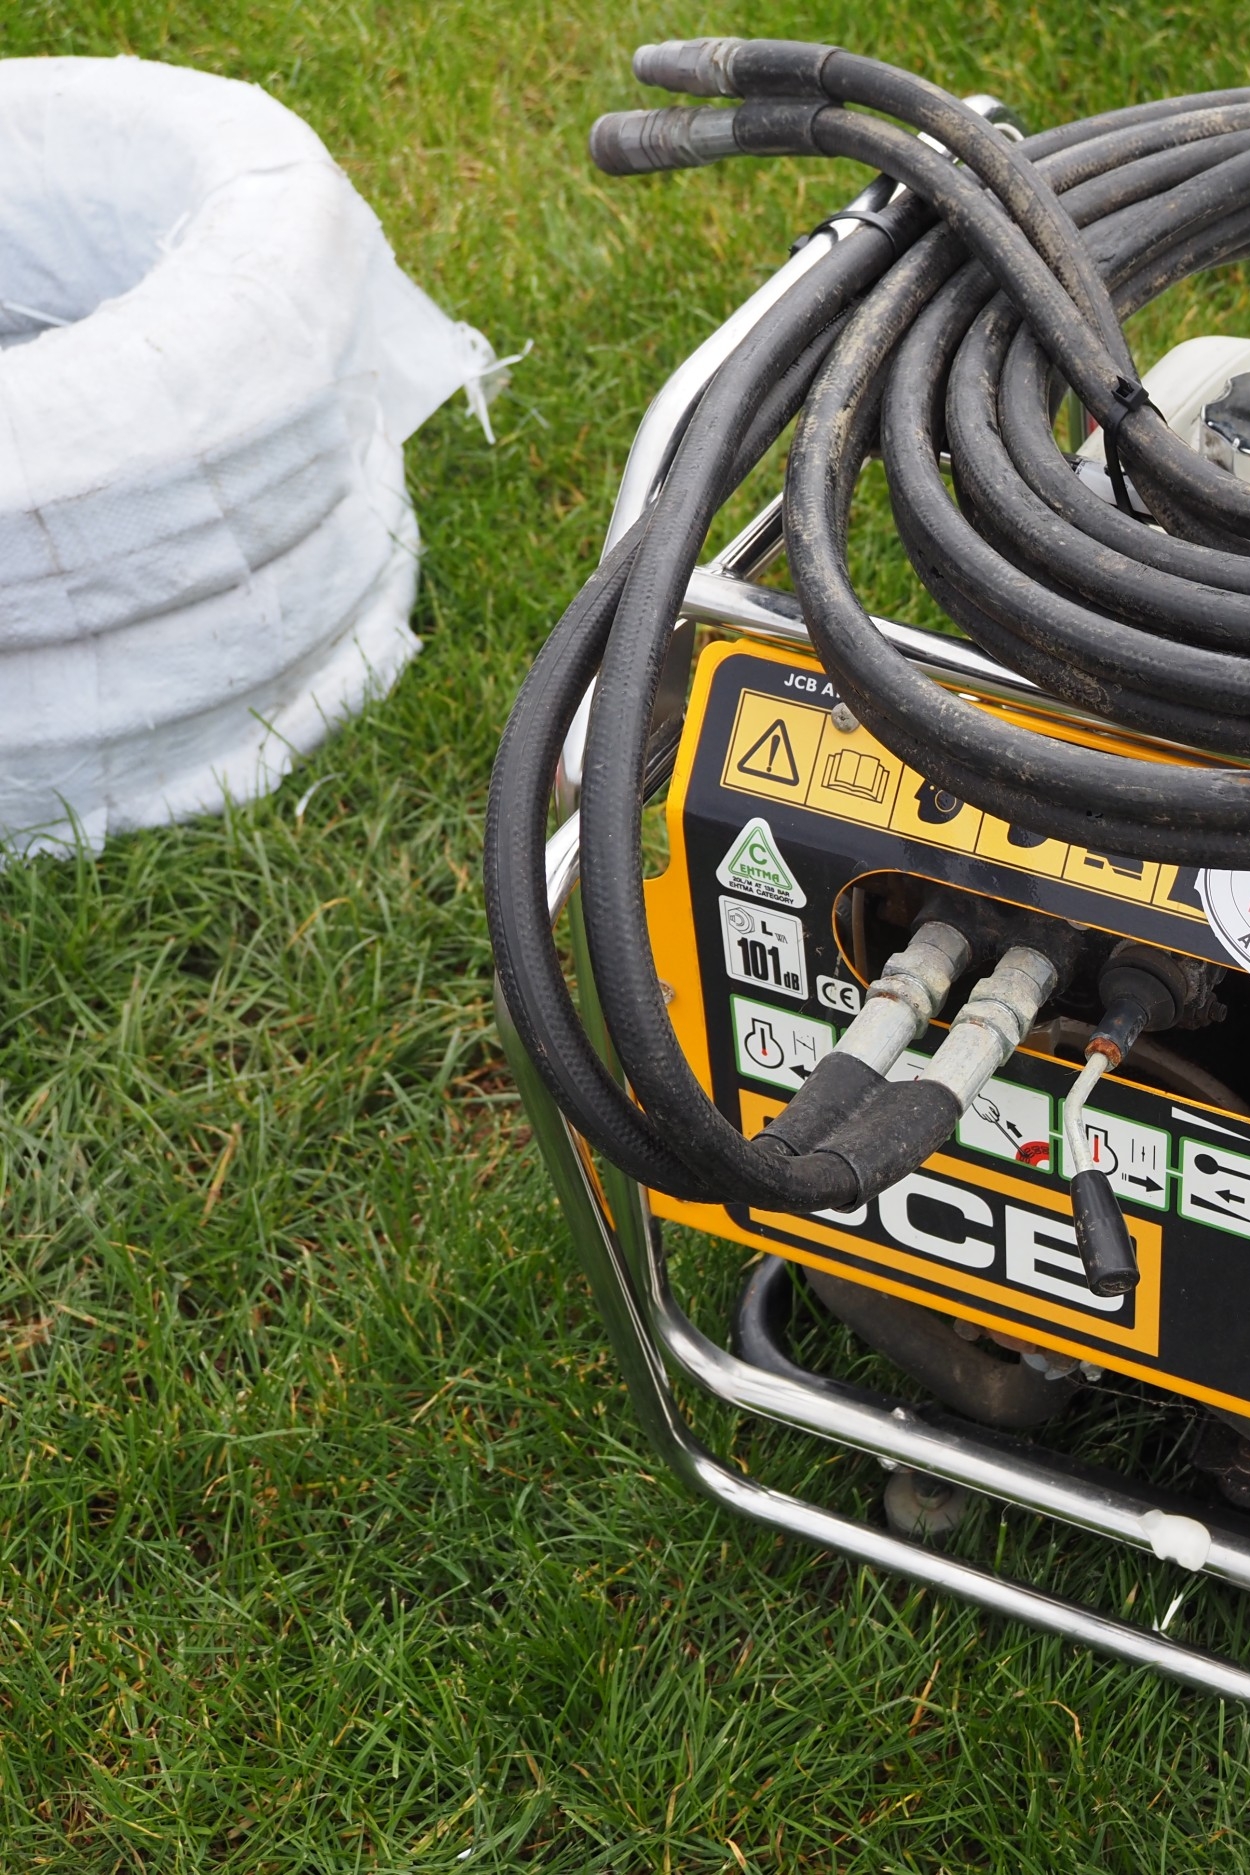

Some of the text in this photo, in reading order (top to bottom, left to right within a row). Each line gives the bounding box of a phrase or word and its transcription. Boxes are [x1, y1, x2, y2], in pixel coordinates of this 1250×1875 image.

[783, 673, 841, 698] JCB A
[749, 843, 767, 865] C
[740, 864, 780, 882] EHTMA
[729, 881, 794, 905] EHTMA CATEGORY
[777, 889, 790, 897] BAR
[822, 982, 854, 1010] CE
